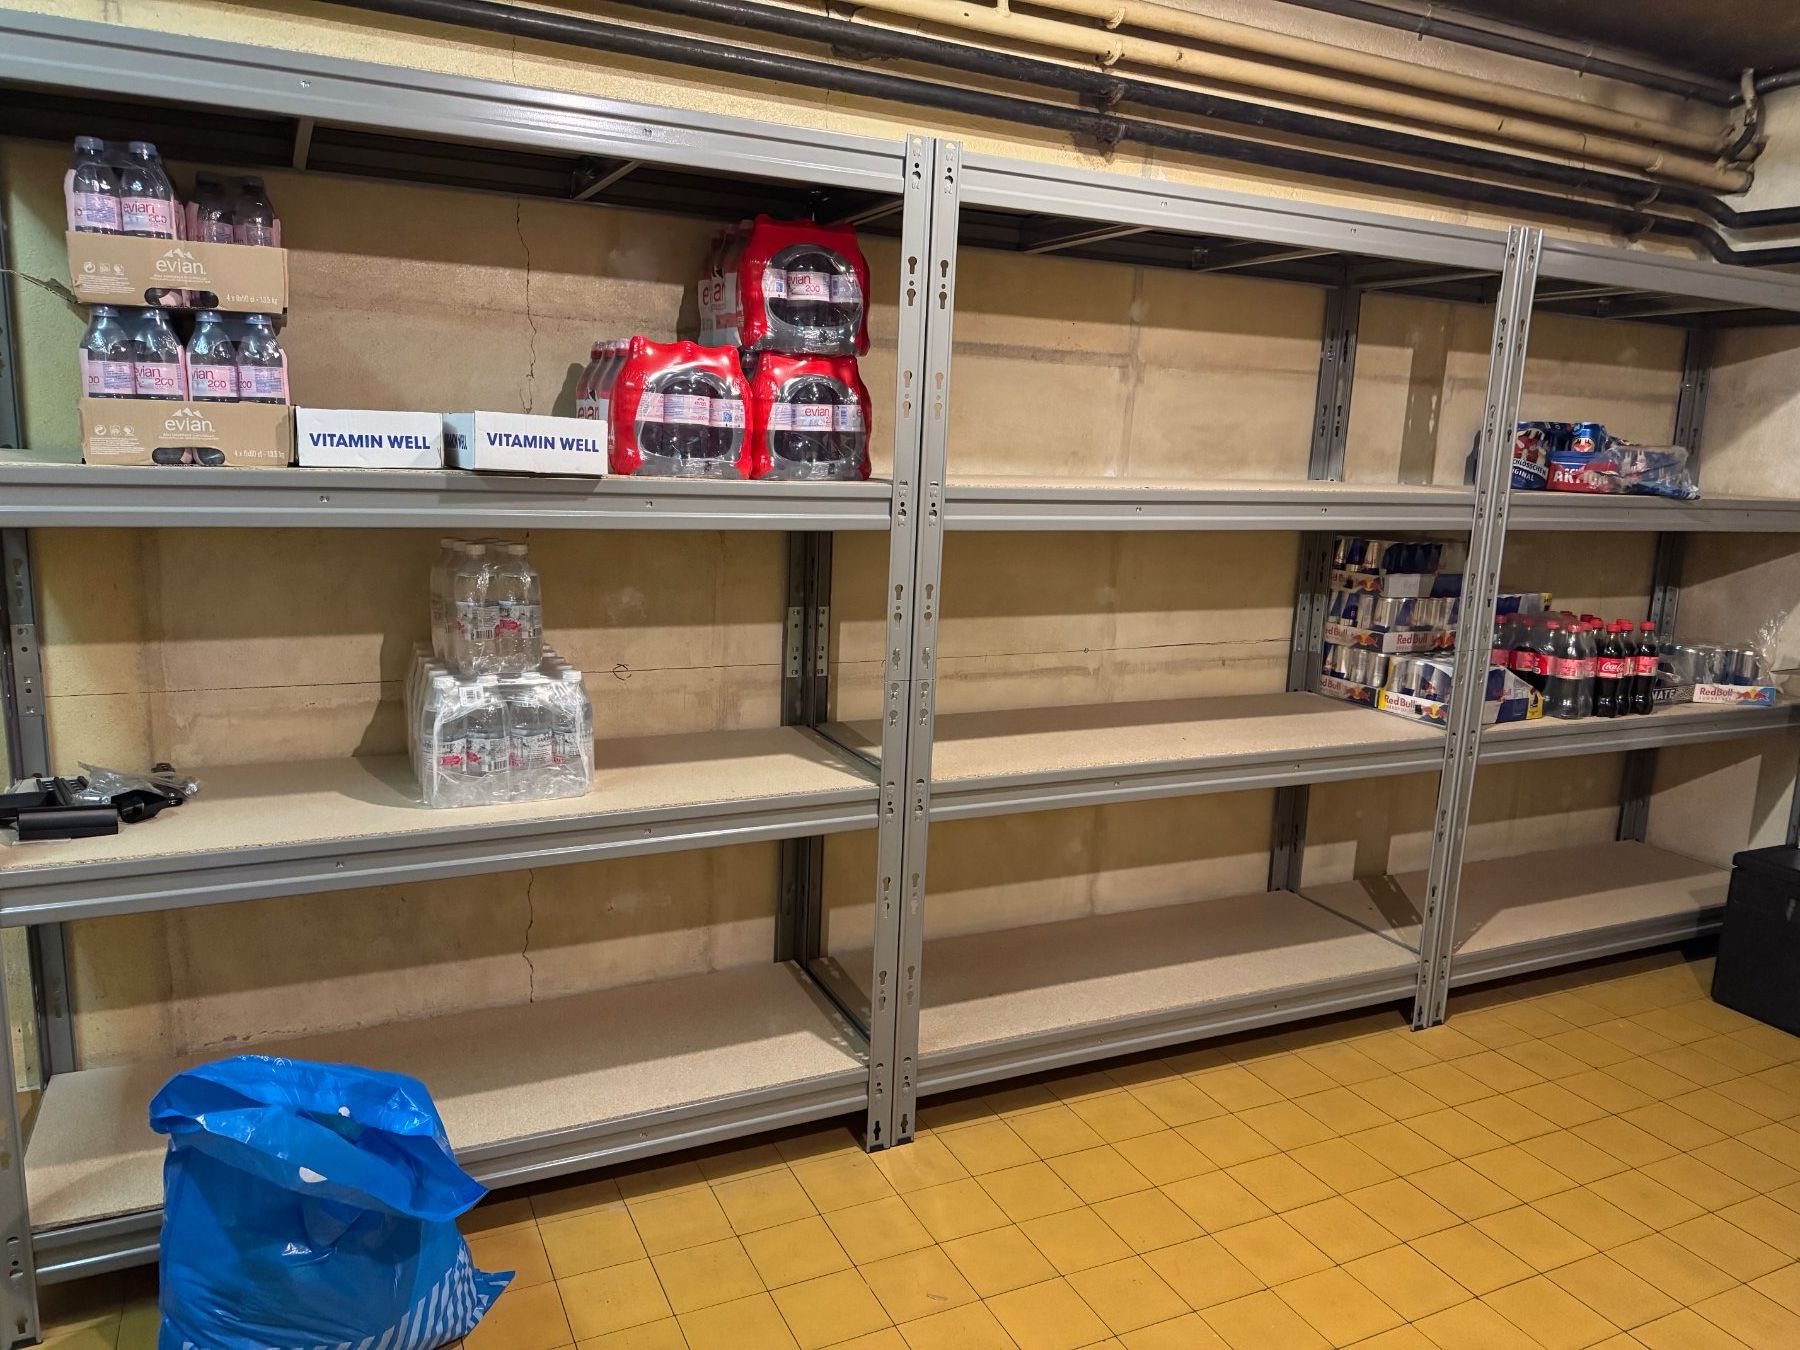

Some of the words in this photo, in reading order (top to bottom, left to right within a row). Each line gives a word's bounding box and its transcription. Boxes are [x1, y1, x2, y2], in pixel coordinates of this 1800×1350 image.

[123, 202, 155, 214] evian
[156, 257, 207, 275] evian
[207, 379, 227, 388] 200
[804, 406, 830, 417] evian
[165, 419, 215, 433] evian
[309, 432, 383, 448] VITAMIN
[387, 434, 431, 450] WELL
[487, 432, 555, 450] VITAMIN
[559, 437, 600, 453] WELL
[1396, 633, 1412, 645] Red
[1413, 635, 1428, 645] Bull
[1700, 687, 1715, 696] Red
[1716, 688, 1733, 697] Bull
[1384, 694, 1399, 706] Red
[1400, 697, 1416, 709] Bull
